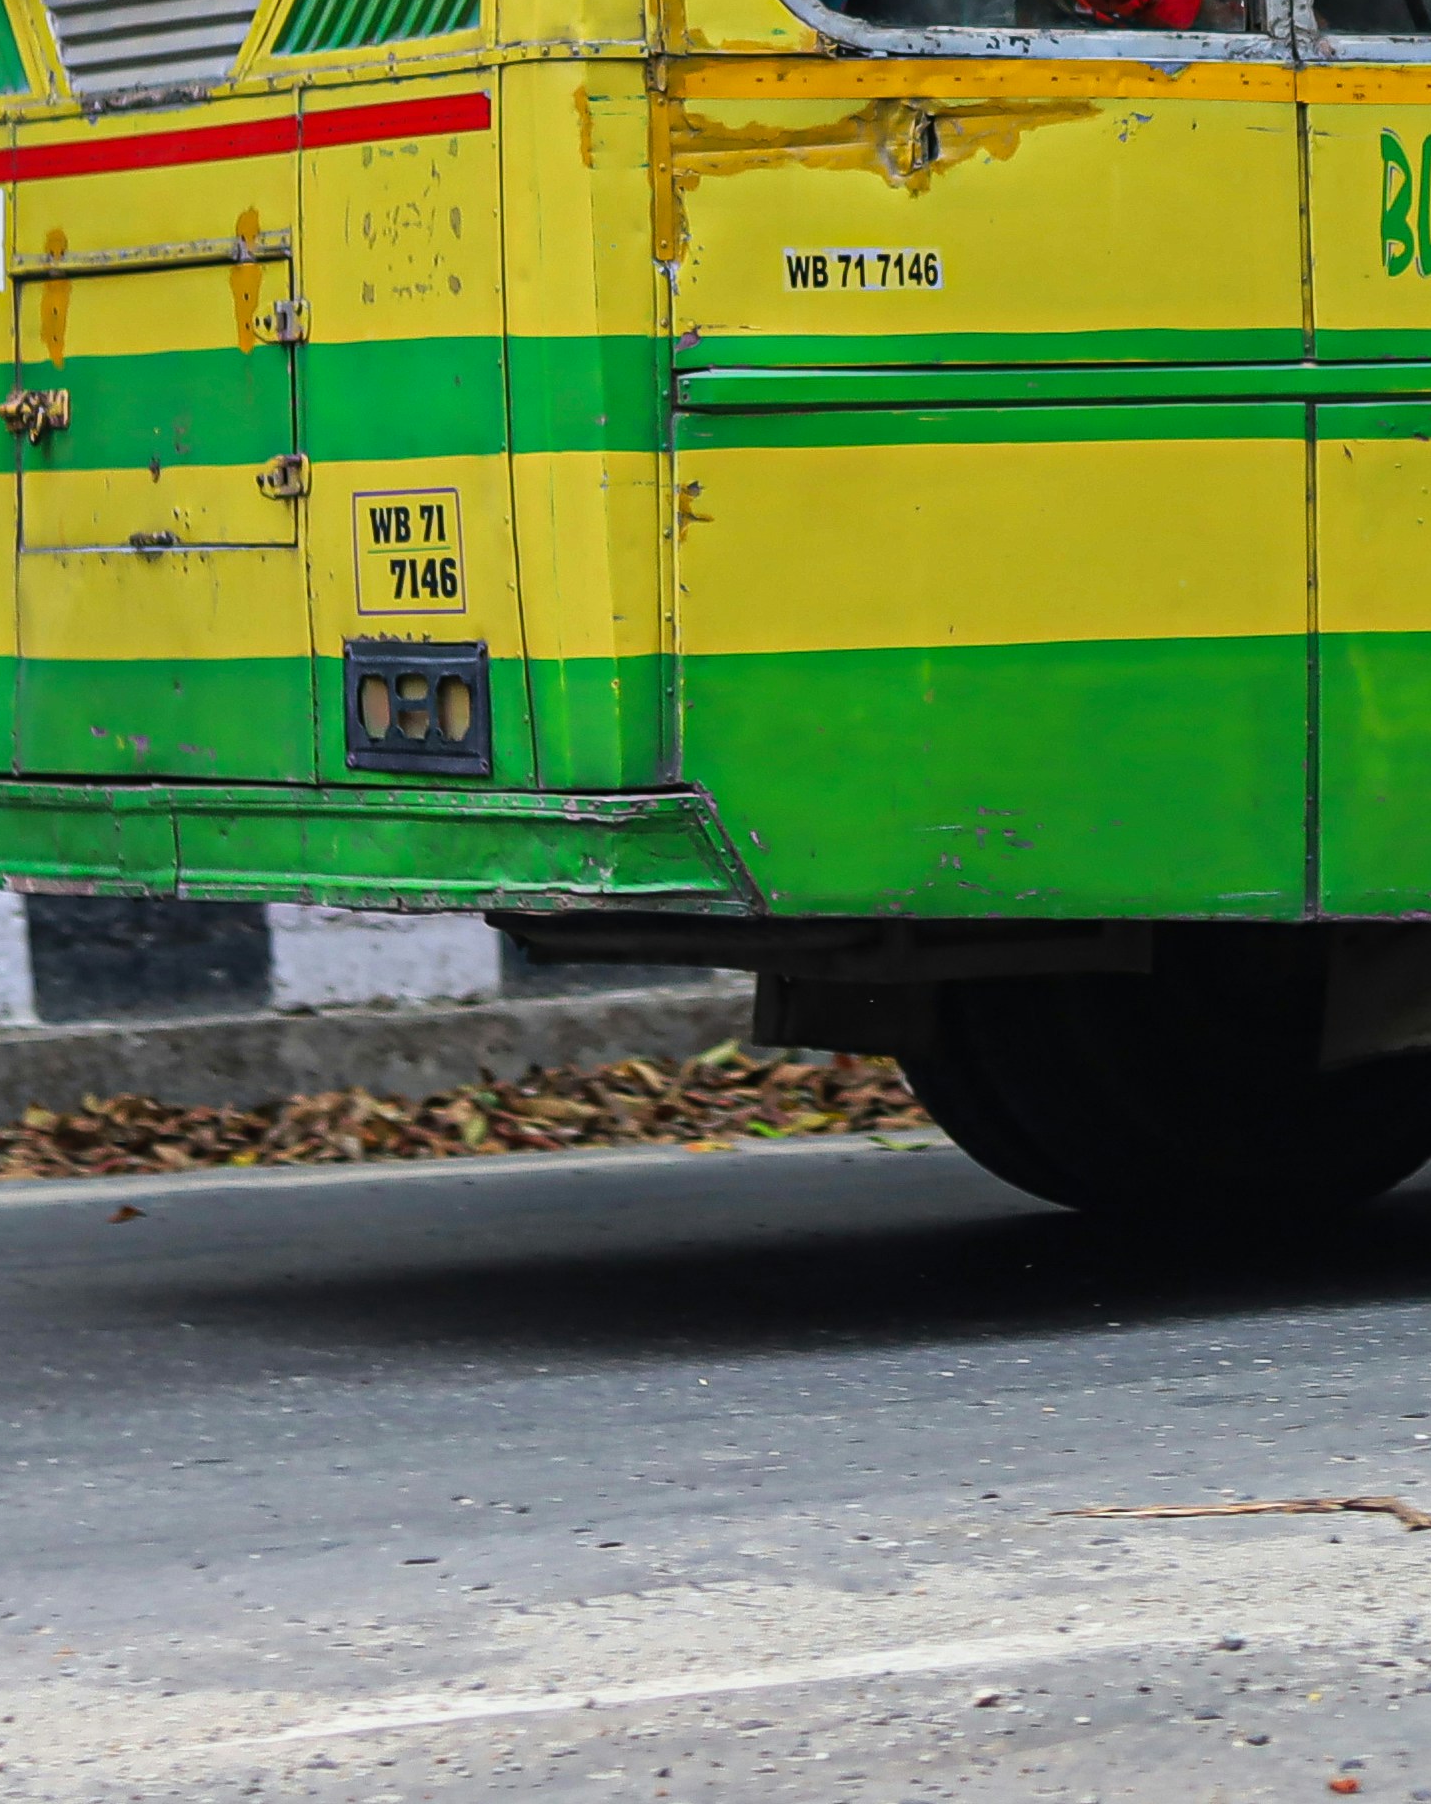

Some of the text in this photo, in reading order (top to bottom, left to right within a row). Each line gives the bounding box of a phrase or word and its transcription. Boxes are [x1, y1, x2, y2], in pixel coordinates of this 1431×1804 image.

[786, 252, 939, 289] WB 71 7146
[369, 503, 446, 544] WB 71
[389, 557, 458, 600] 7146
